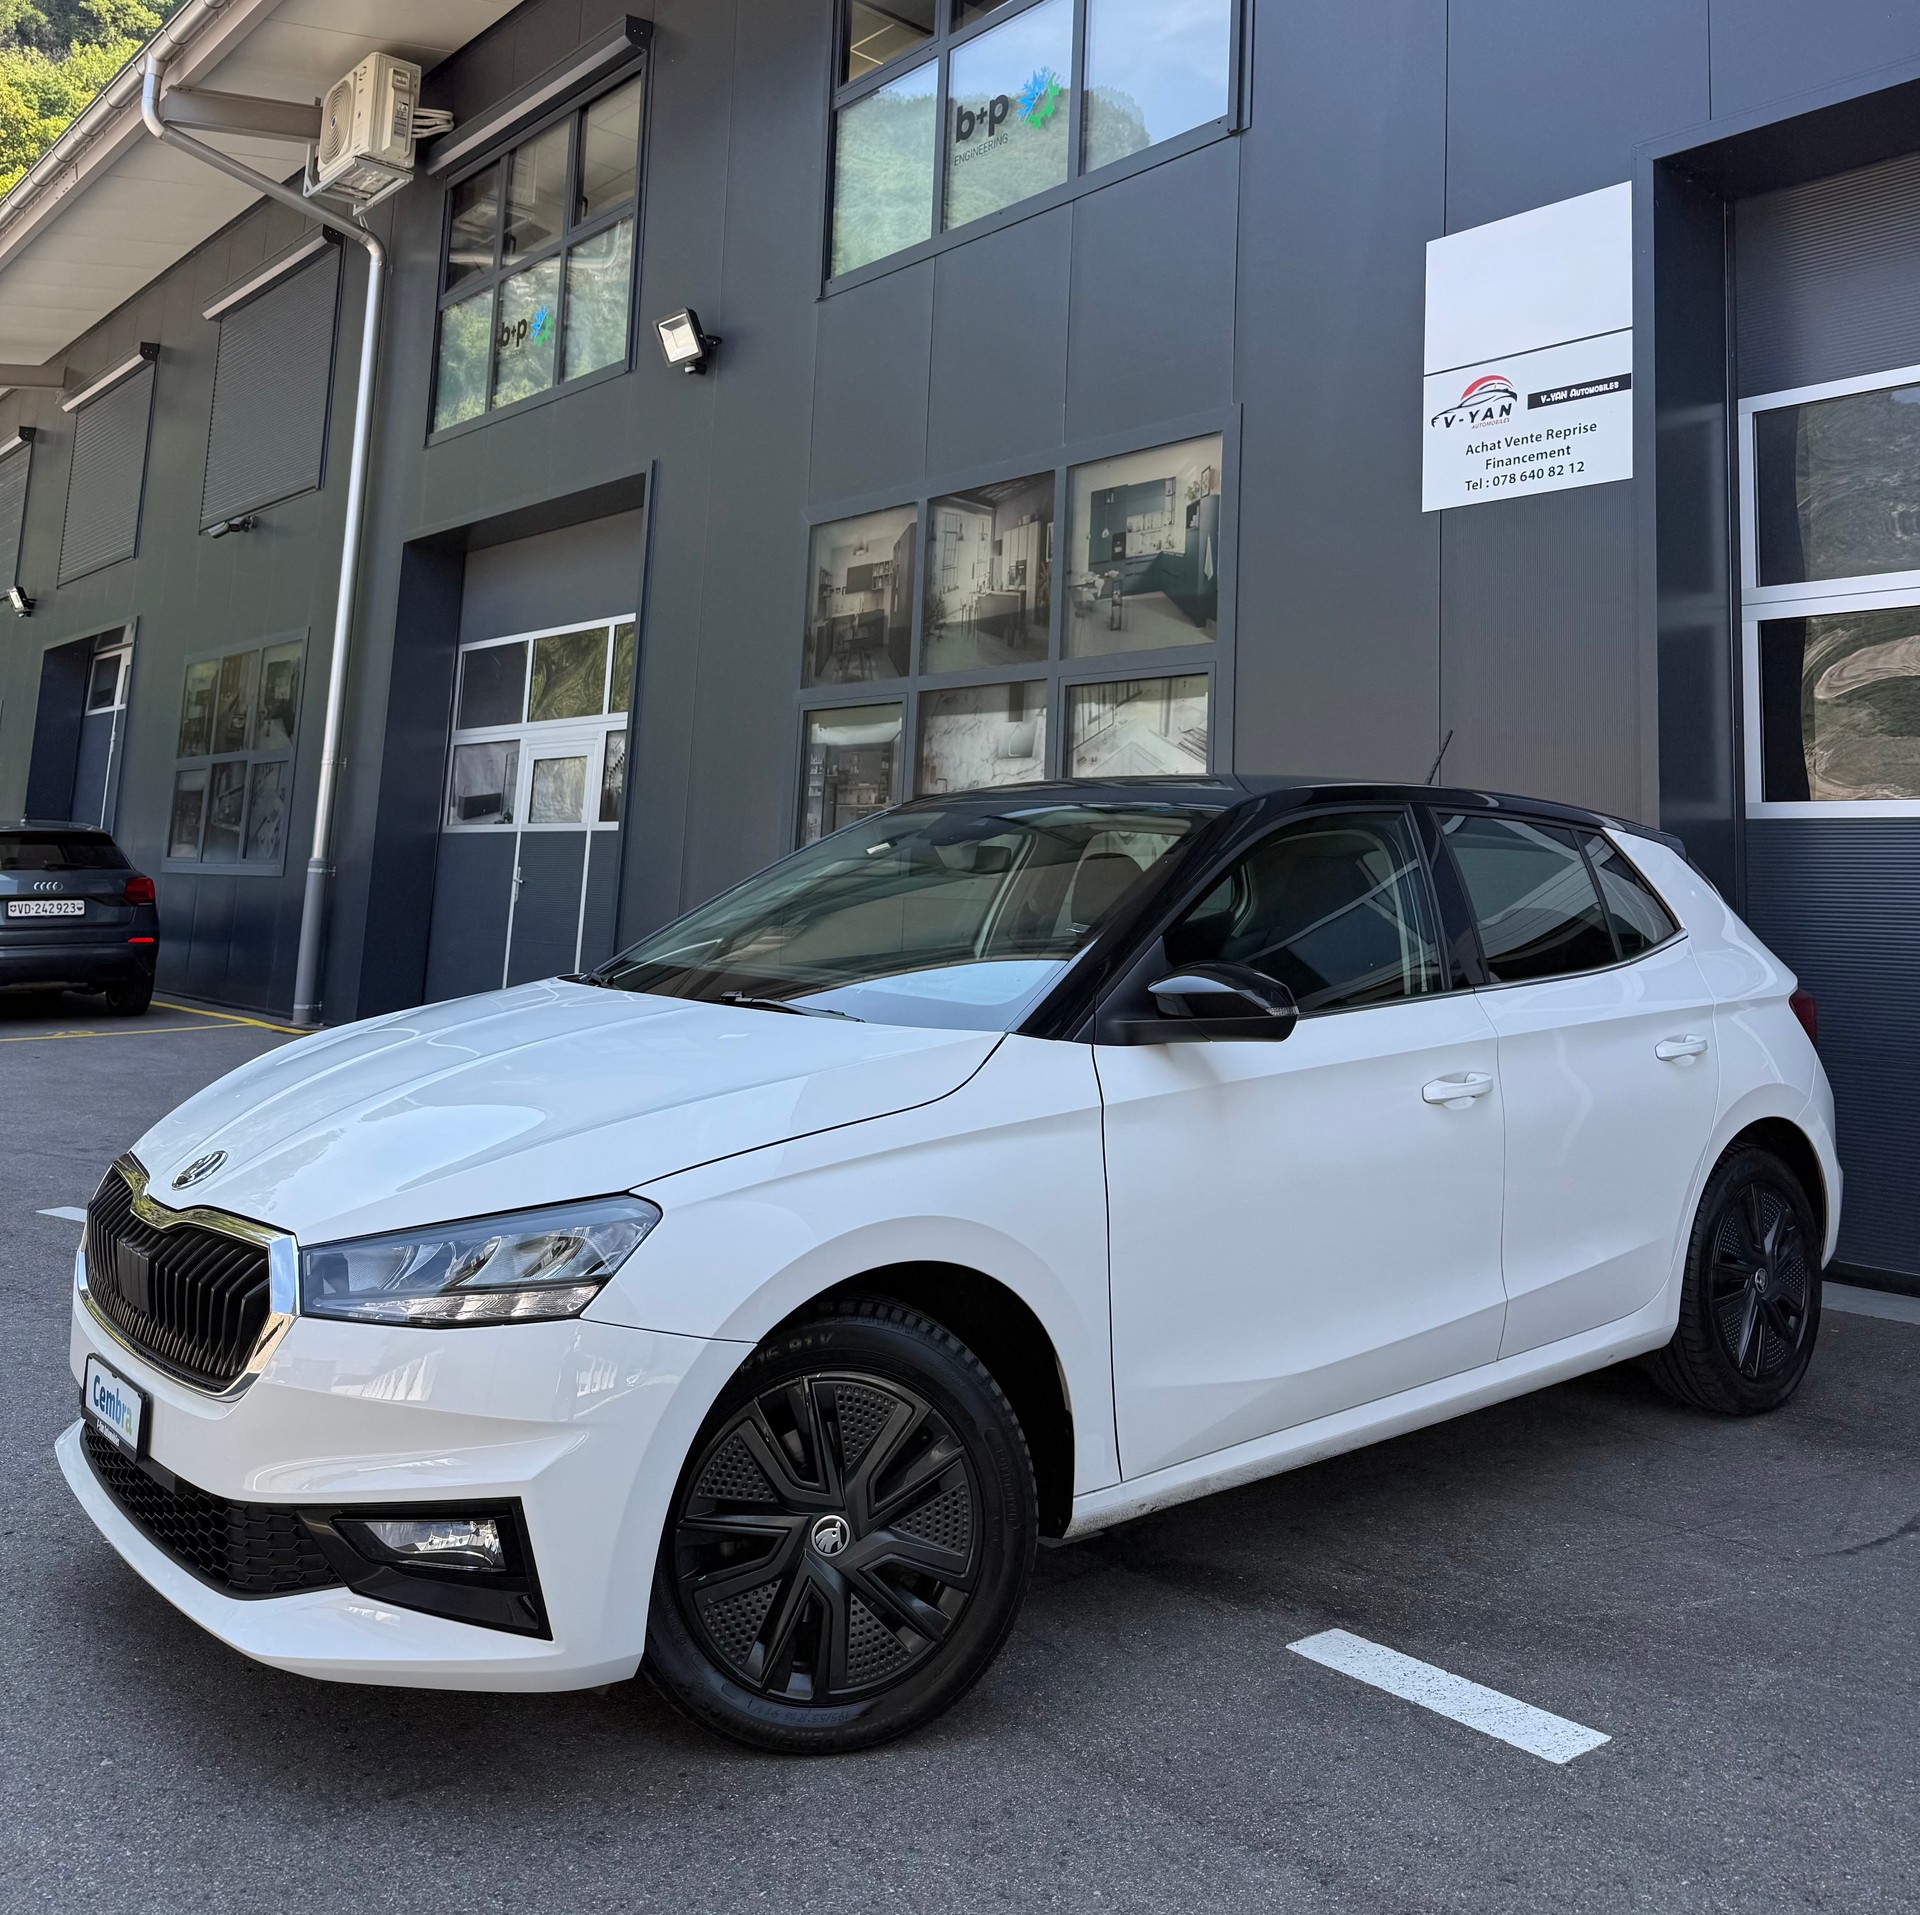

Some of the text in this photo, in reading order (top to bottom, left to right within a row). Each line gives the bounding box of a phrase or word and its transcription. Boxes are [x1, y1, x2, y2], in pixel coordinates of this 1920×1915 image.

[955, 94, 1010, 144] b+p
[953, 132, 1009, 166] ENGINEERING
[500, 318, 528, 347] b+p
[1539, 389, 1569, 404] V-YAN
[1443, 402, 1513, 429] V-YAN
[1471, 417, 1511, 430] AUTOMOBILES
[1465, 421, 1598, 456] Achat Vente Reprise
[1485, 445, 1572, 470] Financement
[1492, 472, 1517, 487] 078
[1519, 467, 1545, 482] 640
[1548, 464, 1565, 477] 82
[1569, 461, 1585, 474] 12
[93, 1374, 132, 1436] Cembra
